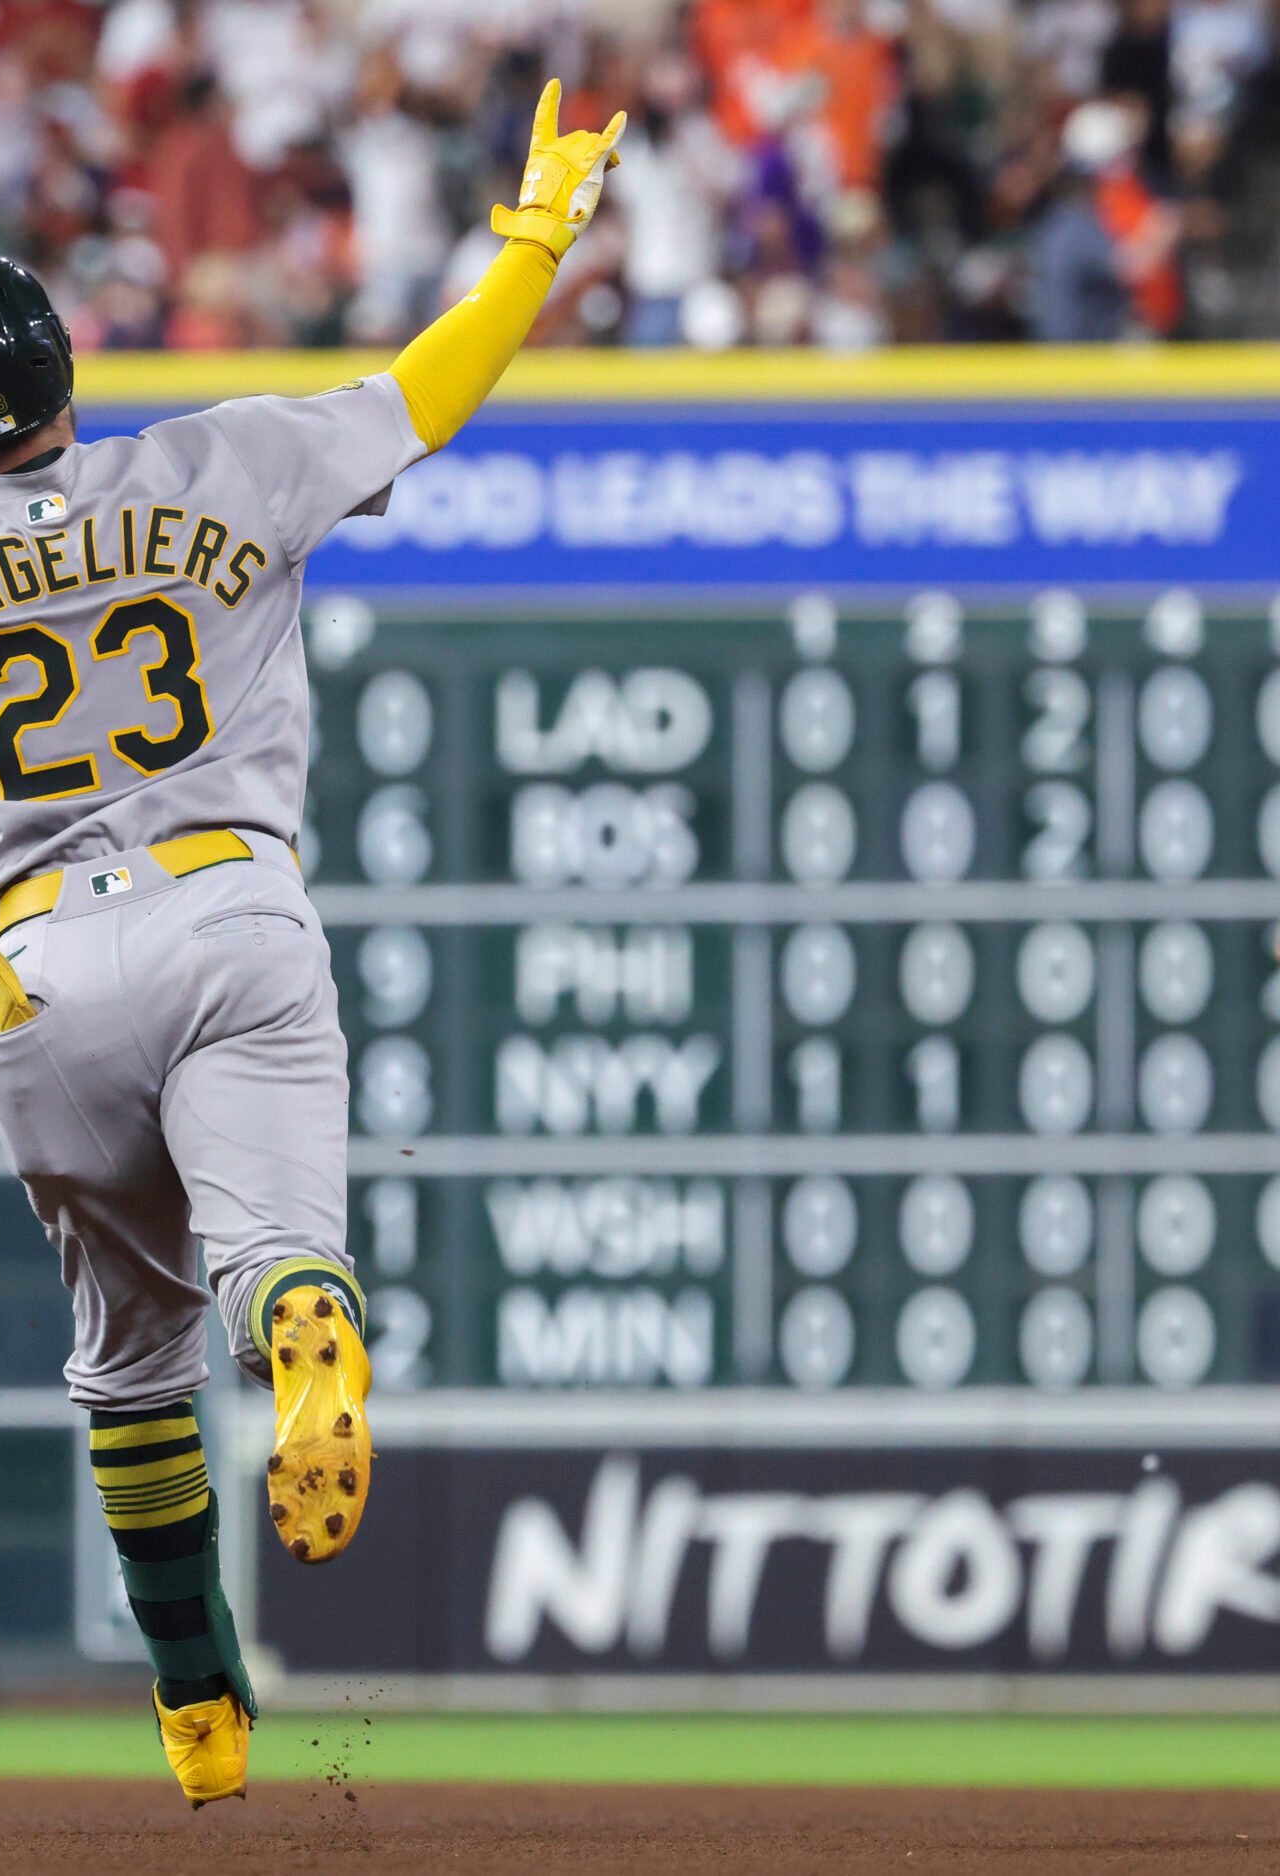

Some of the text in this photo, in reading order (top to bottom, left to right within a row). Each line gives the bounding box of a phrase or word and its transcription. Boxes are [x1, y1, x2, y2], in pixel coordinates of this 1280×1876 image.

[550, 450, 843, 549] LEADS
[847, 450, 1019, 548] THE
[1023, 449, 1245, 547] WAY
[494, 666, 713, 775] LAD
[780, 667, 855, 773] 0
[907, 668, 962, 773] 1
[1022, 666, 1092, 773] 2
[1138, 665, 1214, 771] 0
[510, 780, 699, 890] BOS
[781, 782, 857, 887] 0
[900, 781, 976, 886] 0
[1021, 780, 1092, 886] 2
[1138, 779, 1215, 886] 0
[516, 922, 695, 1027] PHI
[781, 920, 857, 1026] 0
[899, 920, 975, 1026] 0
[1018, 918, 1095, 1025] 0
[1139, 918, 1215, 1024] 0
[494, 1032, 720, 1134] NYY
[787, 1034, 841, 1134] 1
[906, 1034, 961, 1134] 1
[1020, 1032, 1094, 1136] 0
[1138, 1031, 1214, 1137] 0
[485, 1175, 725, 1280] WSH
[782, 1173, 858, 1279] 0
[898, 1173, 975, 1278] 0
[1019, 1173, 1094, 1278] 0
[1136, 1172, 1216, 1278] 0
[496, 1284, 1216, 1391] MIN 0 0 0 0
